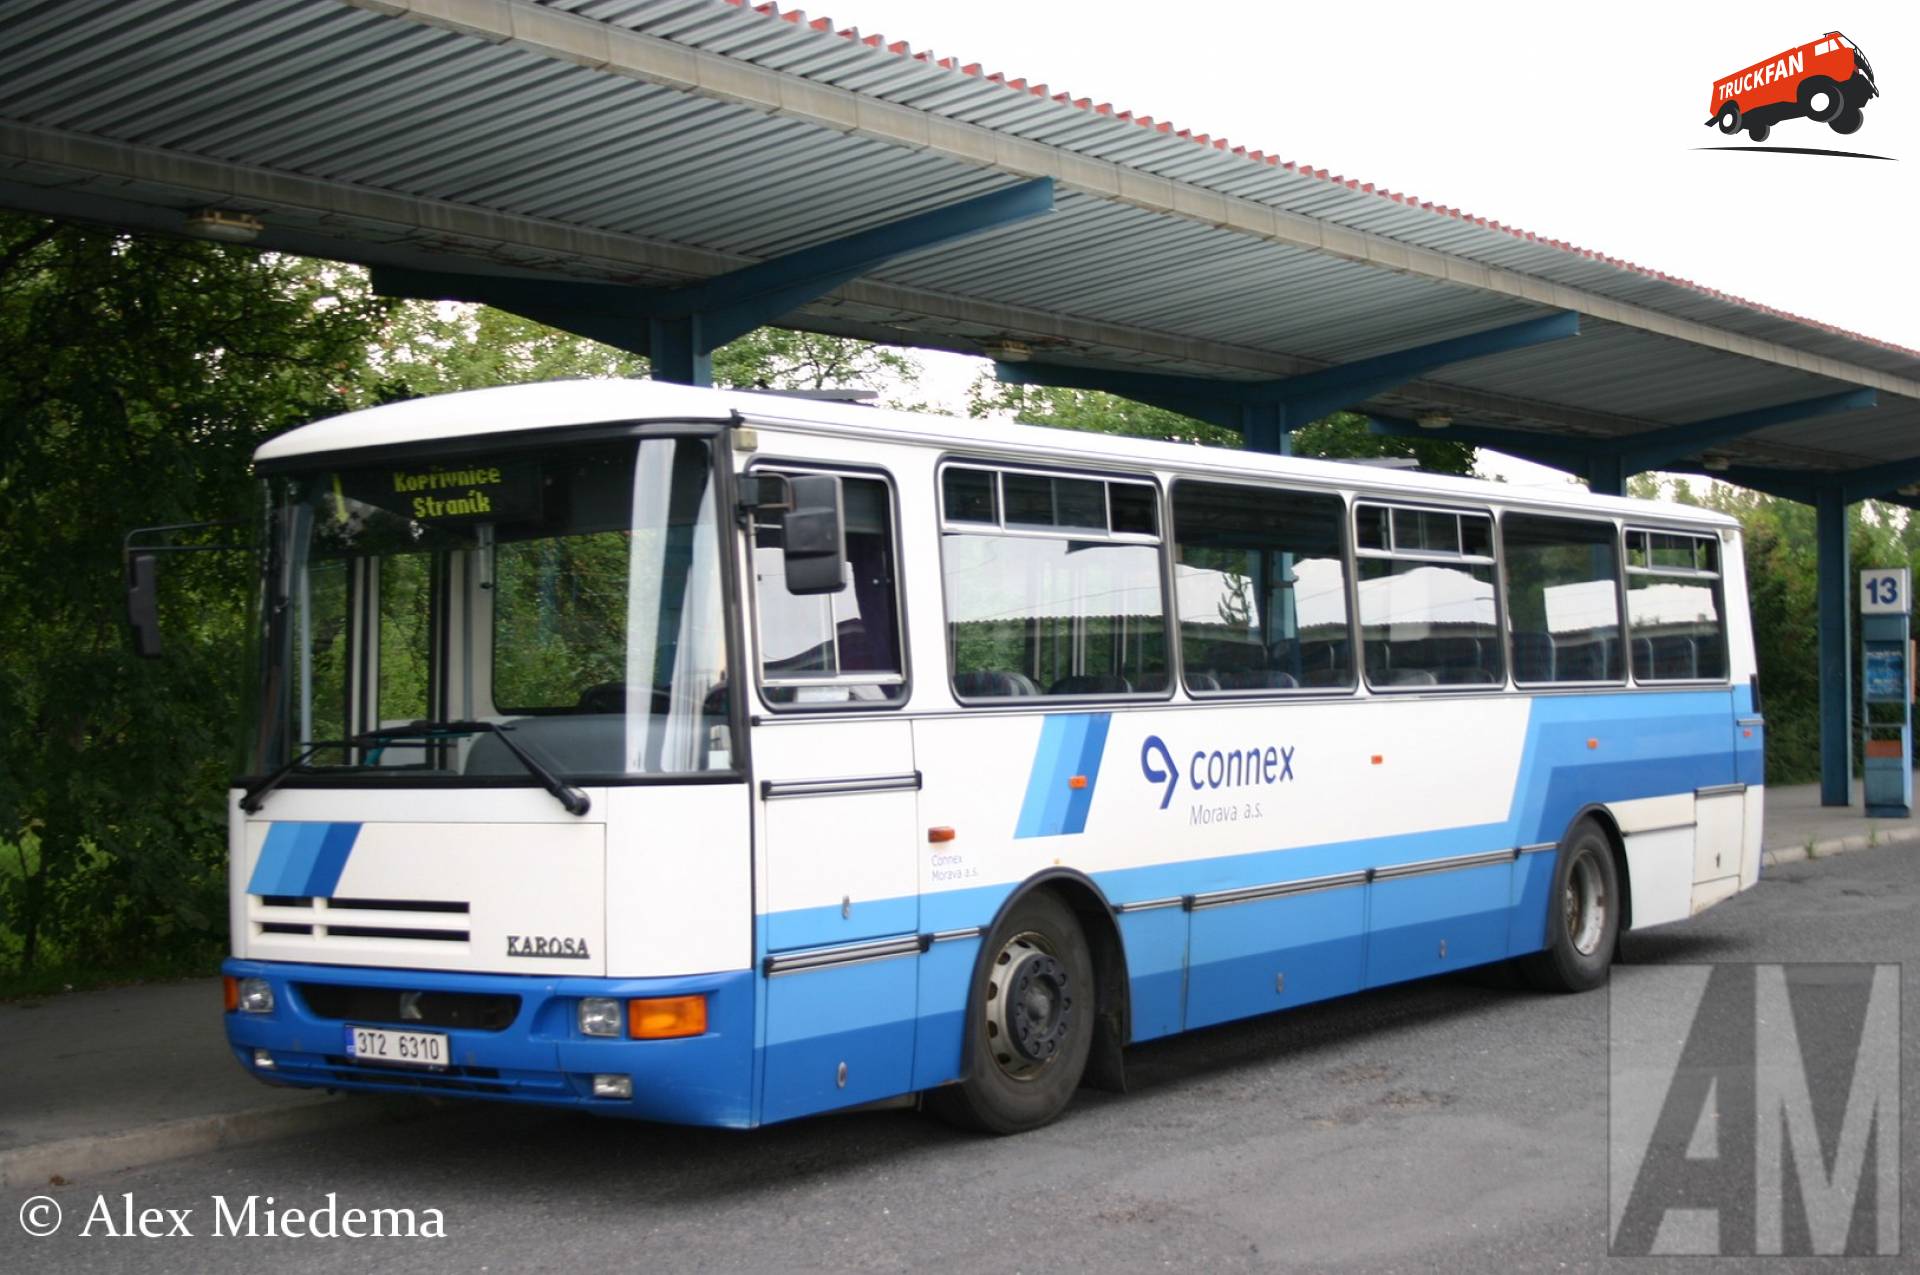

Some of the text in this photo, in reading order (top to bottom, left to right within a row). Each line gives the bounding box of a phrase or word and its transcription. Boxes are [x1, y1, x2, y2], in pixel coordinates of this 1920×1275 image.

[413, 490, 491, 518] Straník
[1865, 577, 1898, 604] 13
[1189, 745, 1295, 790] connex
[1189, 802, 1263, 826] Morava a.s.
[931, 869, 962, 881] Morava
[507, 935, 590, 959] KAROSA
[357, 1031, 387, 1055] 3T2
[399, 1035, 440, 1060] 6310
